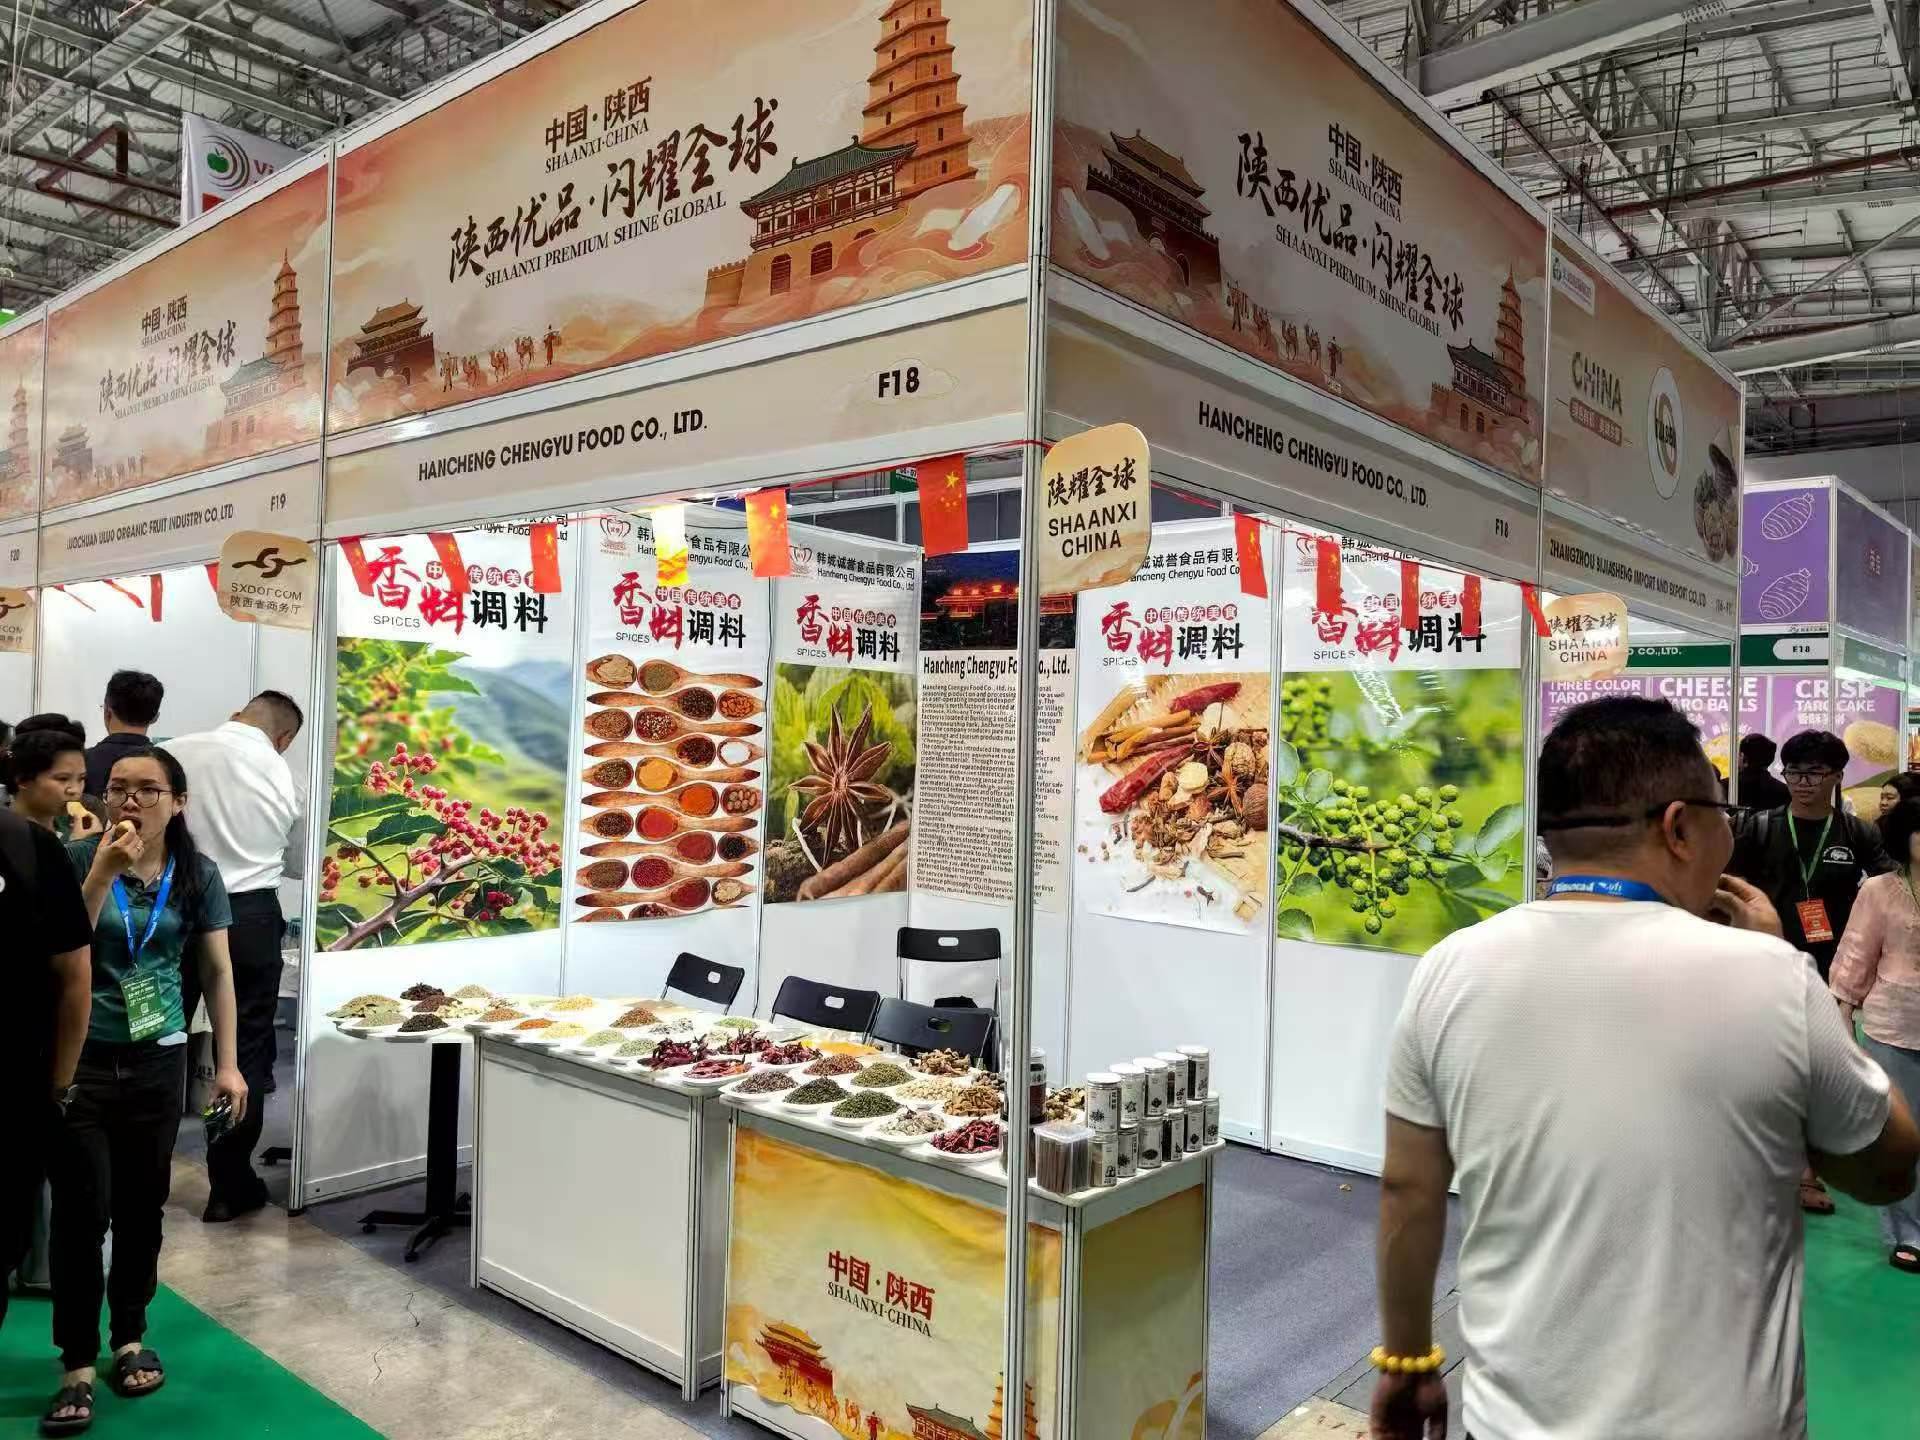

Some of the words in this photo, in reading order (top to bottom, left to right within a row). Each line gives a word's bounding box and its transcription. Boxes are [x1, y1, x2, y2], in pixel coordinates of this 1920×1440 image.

[545, 76, 652, 154] 中国·陕西
[1328, 123, 1402, 204] 中国·陕西
[484, 256, 543, 289] SHAANXI
[544, 232, 609, 269] PREMIUM
[613, 215, 660, 247] SHINE
[662, 191, 727, 225] GLOBAL
[1276, 223, 1327, 269] SHAANXI
[1328, 259, 1376, 299] PREMIUM
[1379, 290, 1407, 318] SHINE
[1408, 307, 1441, 337] GLOBAL
[141, 294, 188, 337] 中国·陕西
[878, 365, 921, 398] F18
[418, 449, 496, 481] HANCHENG
[500, 433, 573, 466] CHENGYU
[577, 424, 625, 452] FOOD
[631, 417, 668, 442] CO.,
[673, 409, 708, 435] LTD.
[1199, 401, 1284, 454] HANCHENG
[1288, 437, 1349, 477] CHENGYU
[1352, 461, 1384, 491] FOOD
[1411, 485, 1431, 508] LTD.
[1048, 456, 1136, 508] 陕耀全球
[271, 494, 286, 512] F19
[117, 517, 148, 542] ORGANIC
[149, 513, 167, 533] FRUIT
[169, 511, 202, 530] INDUSTRY
[1048, 501, 1136, 537] SHAANXI
[1495, 519, 1509, 538] F18
[1062, 529, 1122, 557] CHINA
[1550, 539, 1594, 570] ZHANGZHOU
[714, 557, 733, 568] Food
[817, 551, 915, 580] 韩城诚誉食品有限公司
[1168, 569, 1204, 580] Chengyu
[1206, 566, 1226, 577] Food
[655, 586, 742, 610] 中国传统美食
[373, 615, 421, 628] SPICES
[831, 607, 897, 628] 中国传统美食
[1145, 603, 1238, 624] 中国传统美食
[616, 632, 650, 643] SPICES
[797, 648, 827, 658] SPICES
[1102, 657, 1138, 667] SPICES
[1313, 650, 1356, 660] SPICES
[1559, 651, 1608, 664] CHINA
[924, 656, 965, 679] Hancheng
[967, 655, 1006, 679] Chengyu
[1008, 657, 1017, 674] Fo
[1053, 654, 1070, 674] Ltd.
[1549, 692, 1587, 703] TARO
[1595, 680, 1641, 691] COLOR
[1707, 699, 1758, 712] BALS
[1836, 701, 1875, 712] CAKE
[828, 1249, 935, 1321] 中国·陕西
